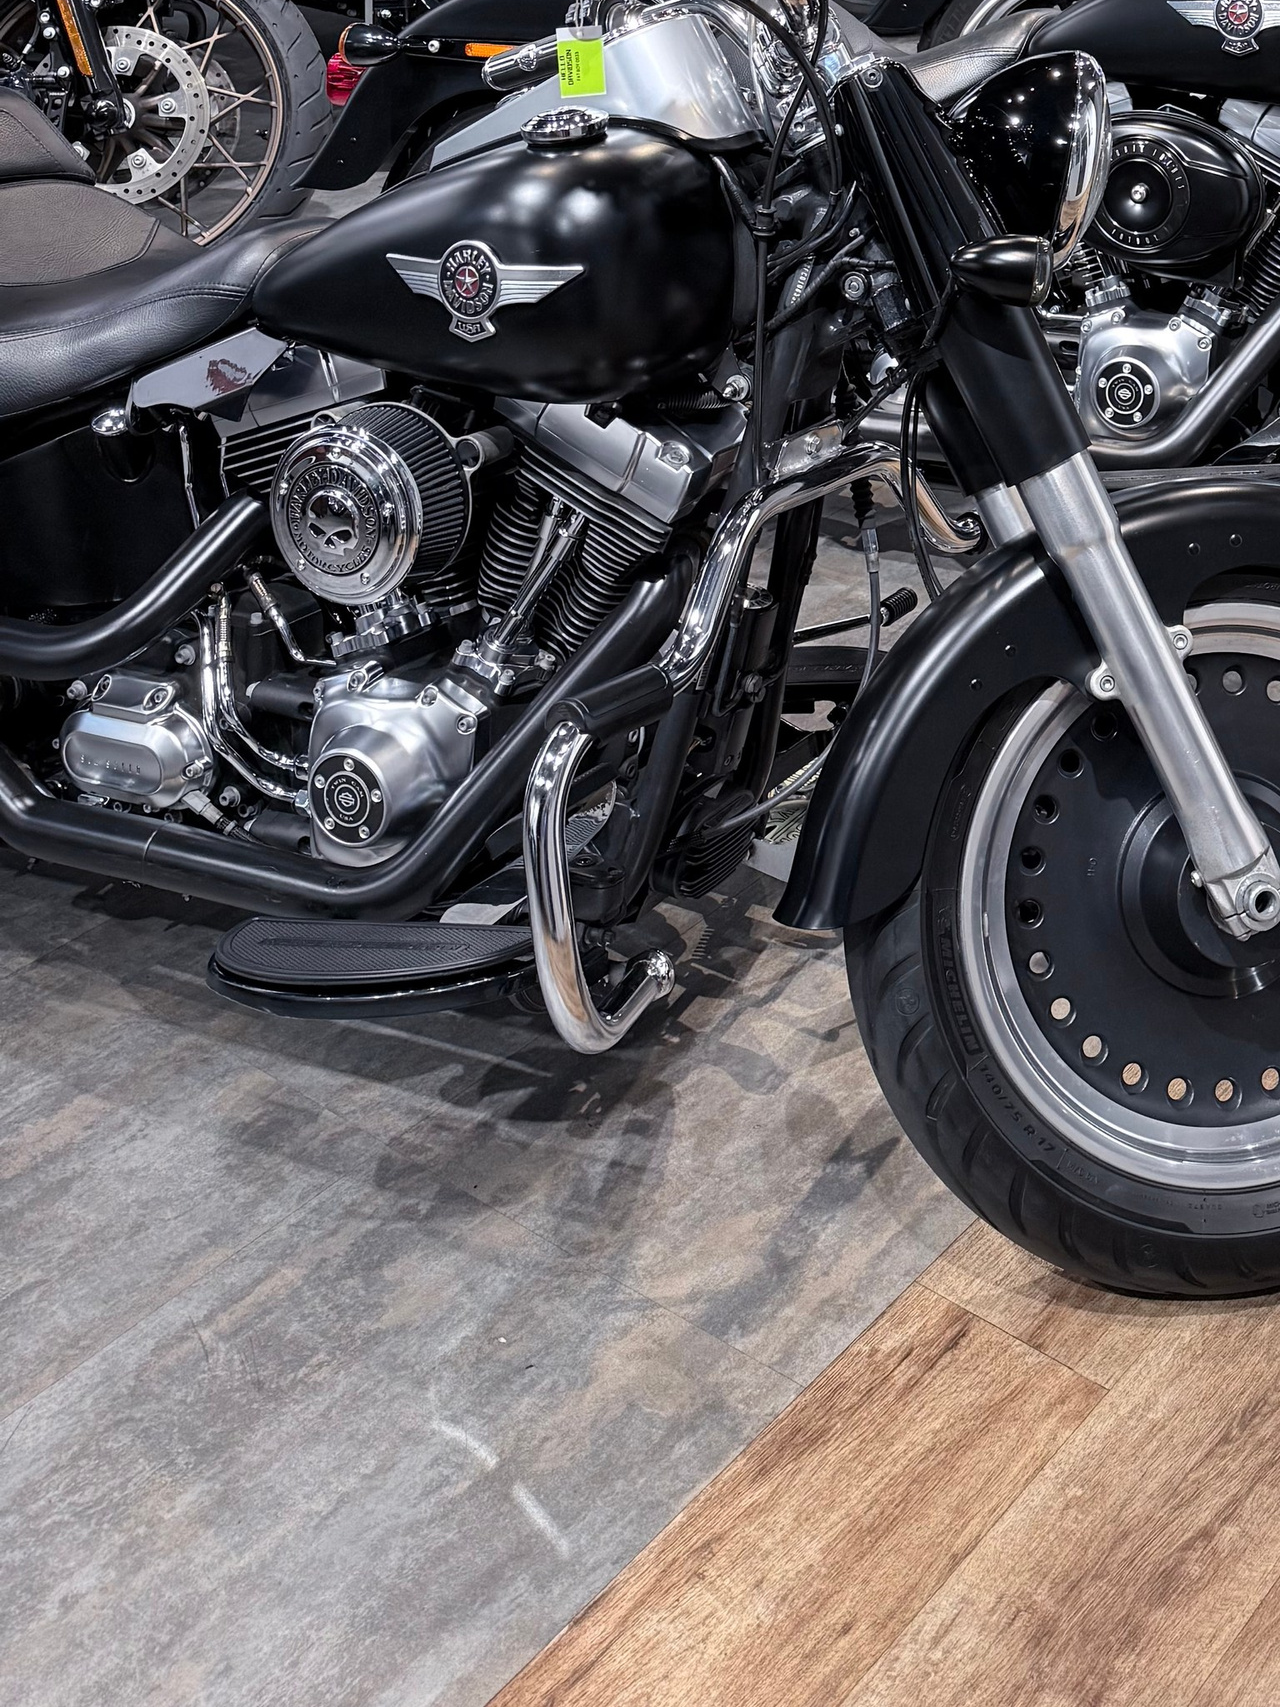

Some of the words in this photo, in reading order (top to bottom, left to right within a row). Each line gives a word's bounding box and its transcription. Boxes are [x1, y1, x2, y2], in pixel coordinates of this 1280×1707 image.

[446, 249, 492, 276] HARLEY
[443, 279, 494, 315] DAVIDSON
[939, 932, 979, 1054] MICHELIN
[979, 1064, 1022, 1123] 140/75
[1023, 1124, 1036, 1138] R
[1036, 1137, 1056, 1153] 17
